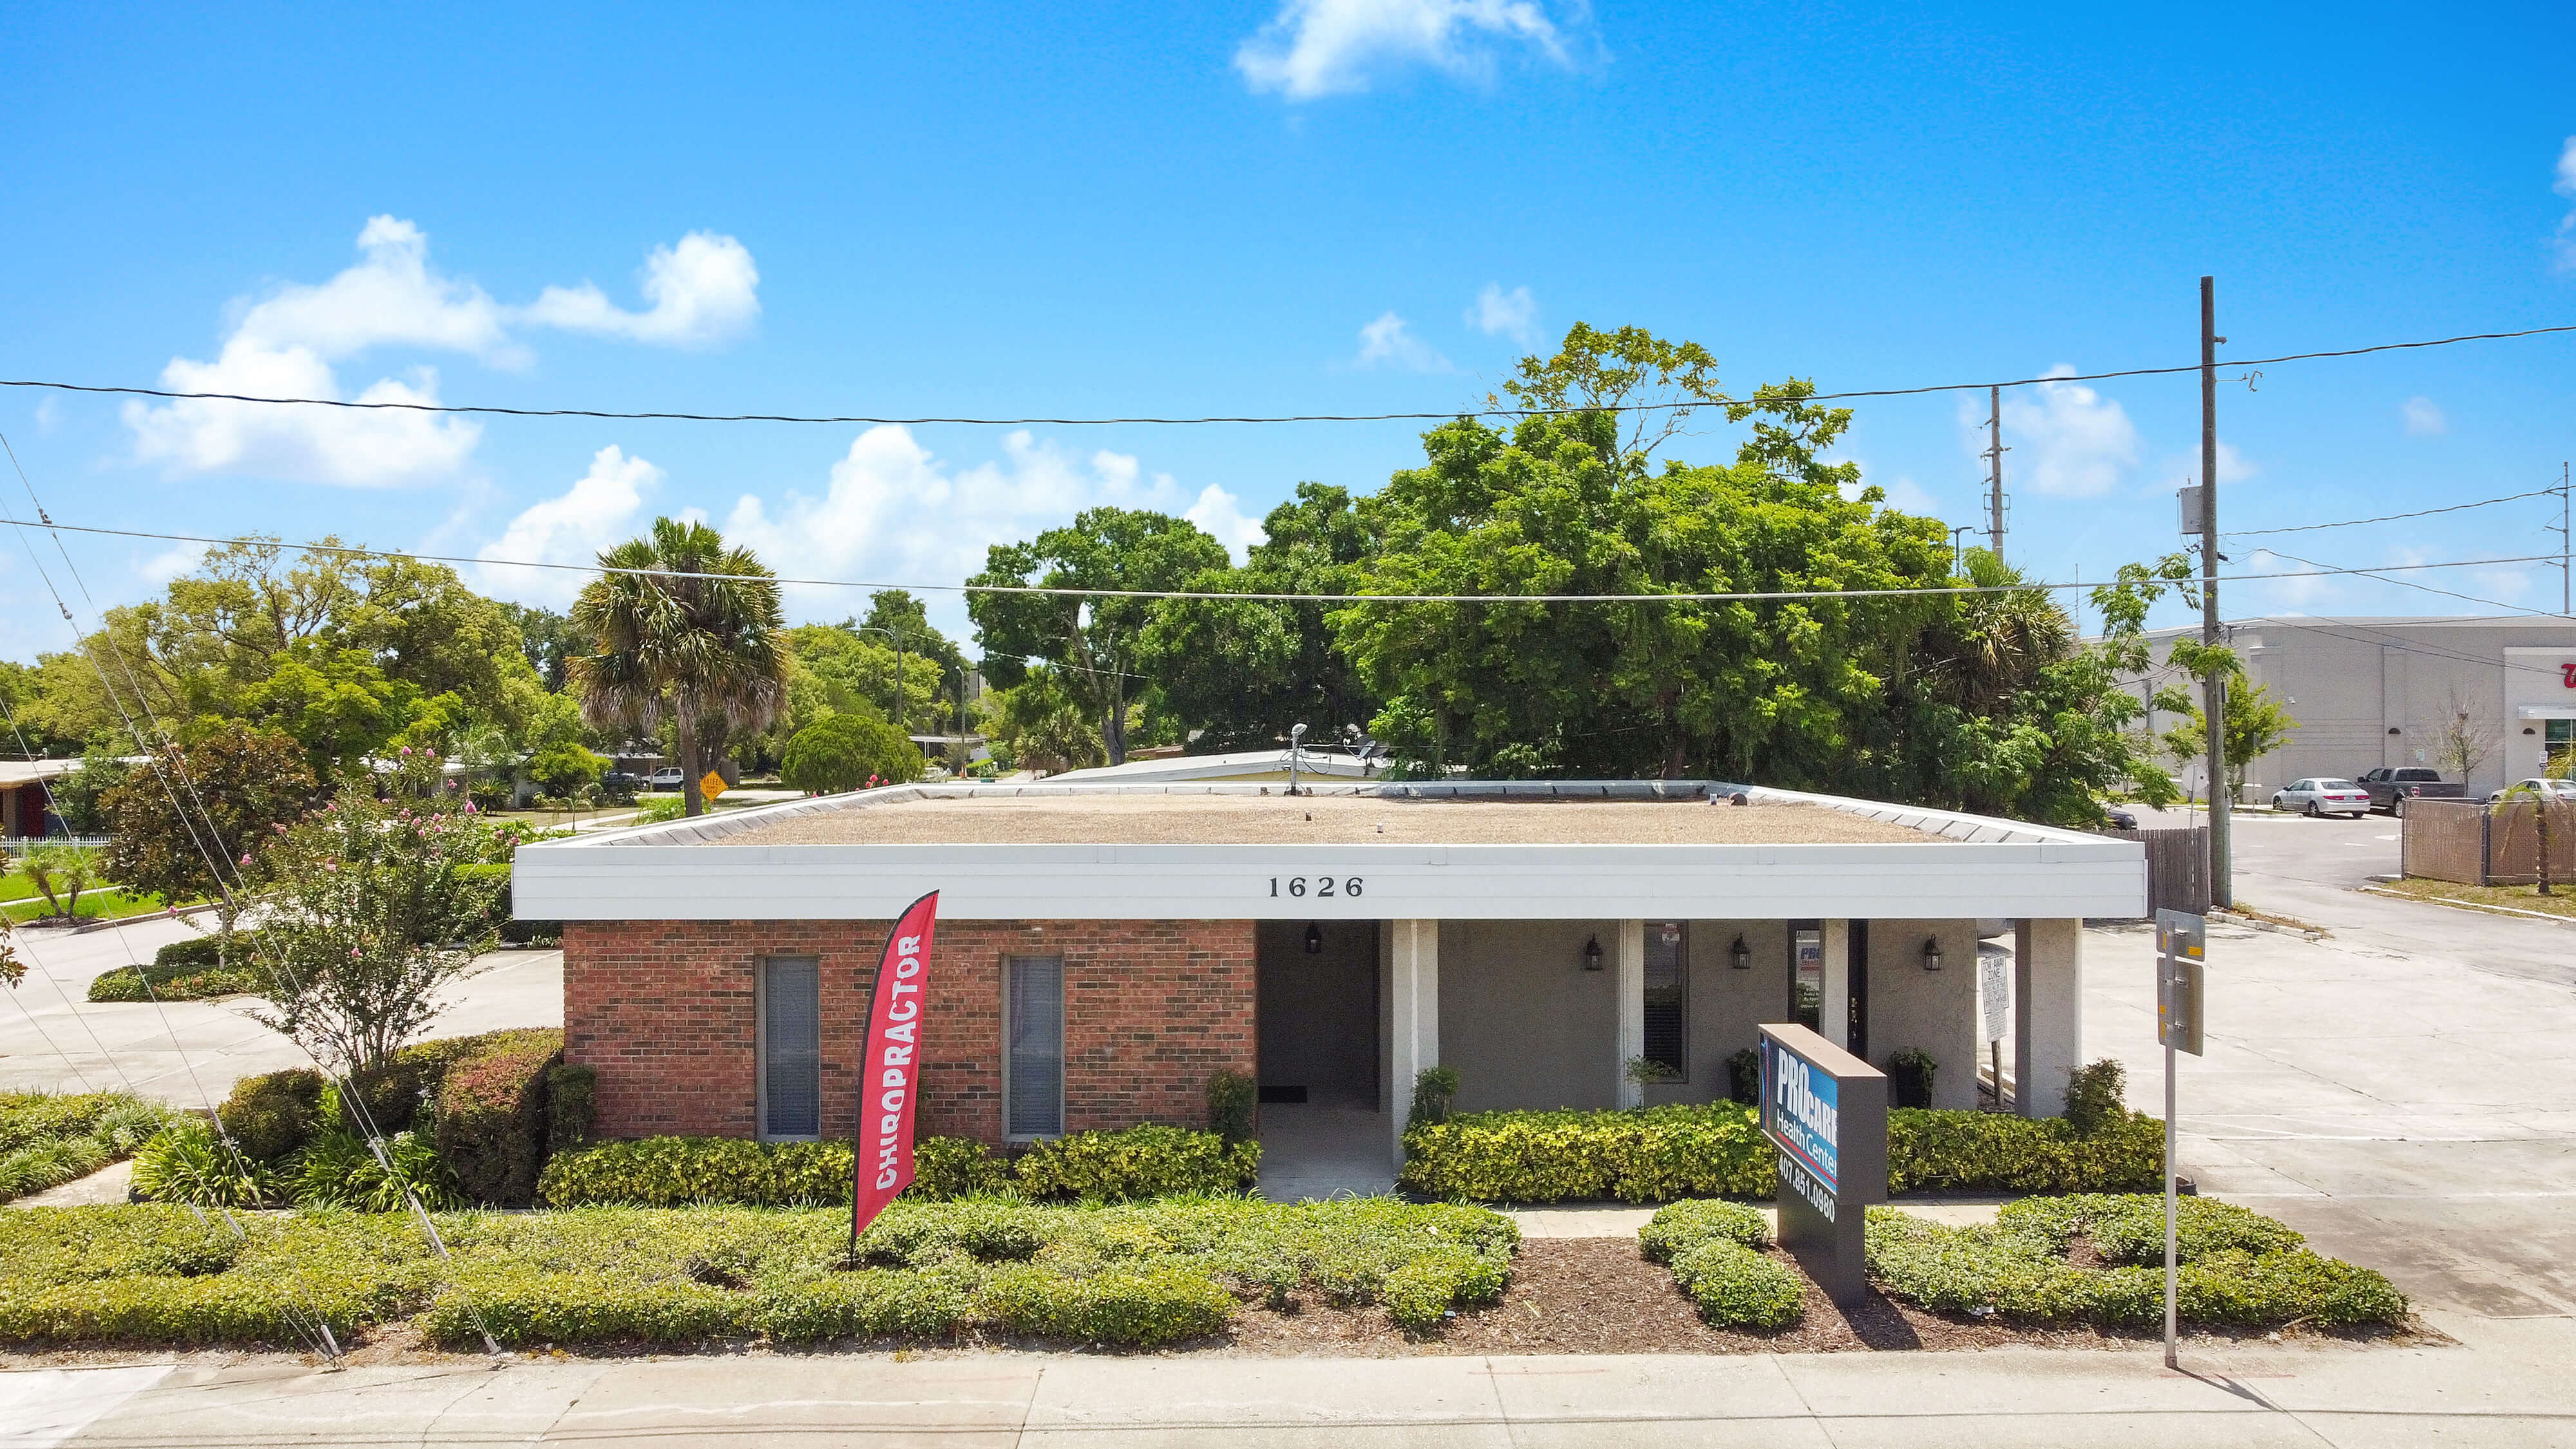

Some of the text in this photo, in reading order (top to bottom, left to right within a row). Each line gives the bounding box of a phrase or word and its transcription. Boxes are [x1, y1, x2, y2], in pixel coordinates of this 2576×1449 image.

[1270, 877, 1363, 897] 1626
[1987, 967, 2000, 980] ZONE
[876, 934, 921, 1190] CHIROPRACTOR
[1777, 1108, 1806, 1151] Health
[1779, 1153, 1835, 1224] 407.851.0980
